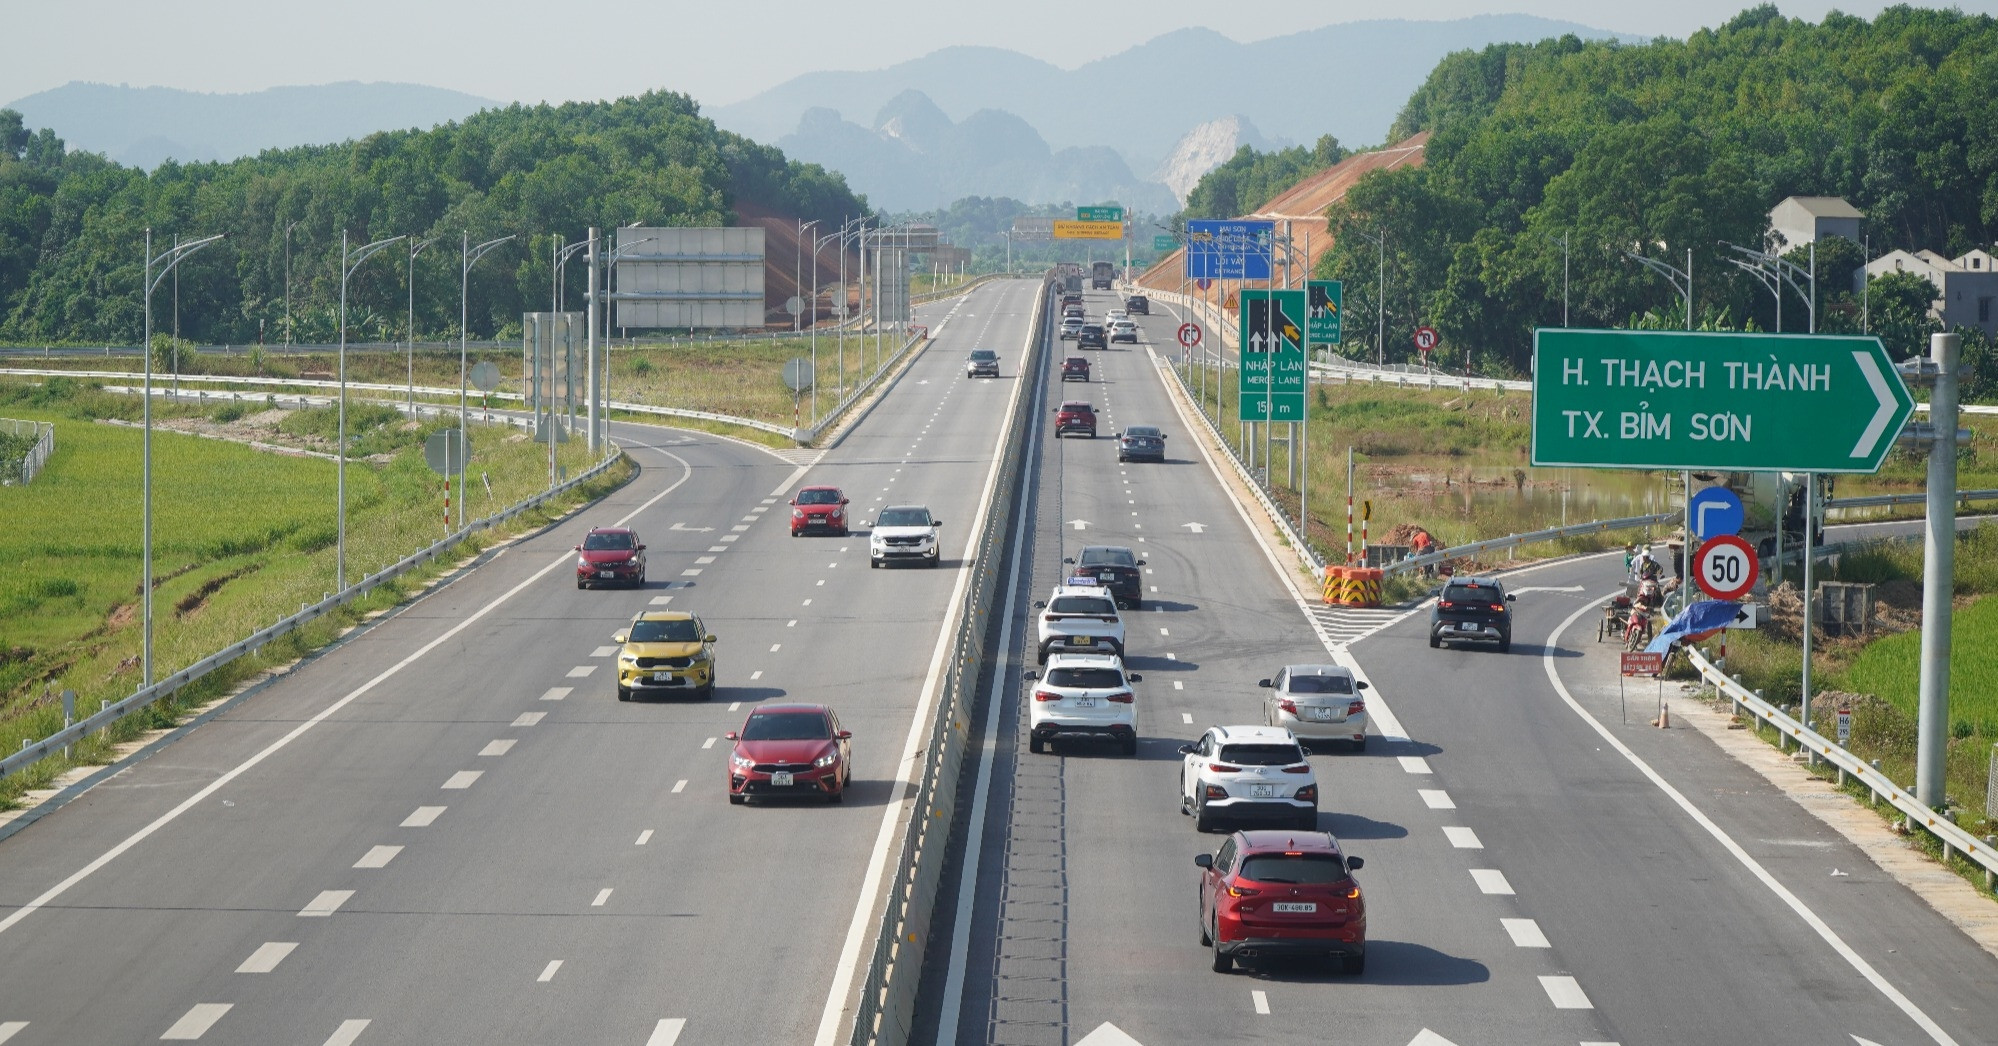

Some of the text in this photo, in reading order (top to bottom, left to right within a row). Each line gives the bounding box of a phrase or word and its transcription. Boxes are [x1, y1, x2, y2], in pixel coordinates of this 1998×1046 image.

[1245, 358, 1303, 373] NHẬP LÀN
[1247, 376, 1301, 384] MERGE LANE
[1562, 354, 1831, 393] H. THẠCH THÀNH
[1279, 405, 1290, 413] m
[1562, 400, 1751, 442] TX. BỈM SƠN
[1712, 554, 1740, 583] 50
[1839, 716, 1849, 725] H6
